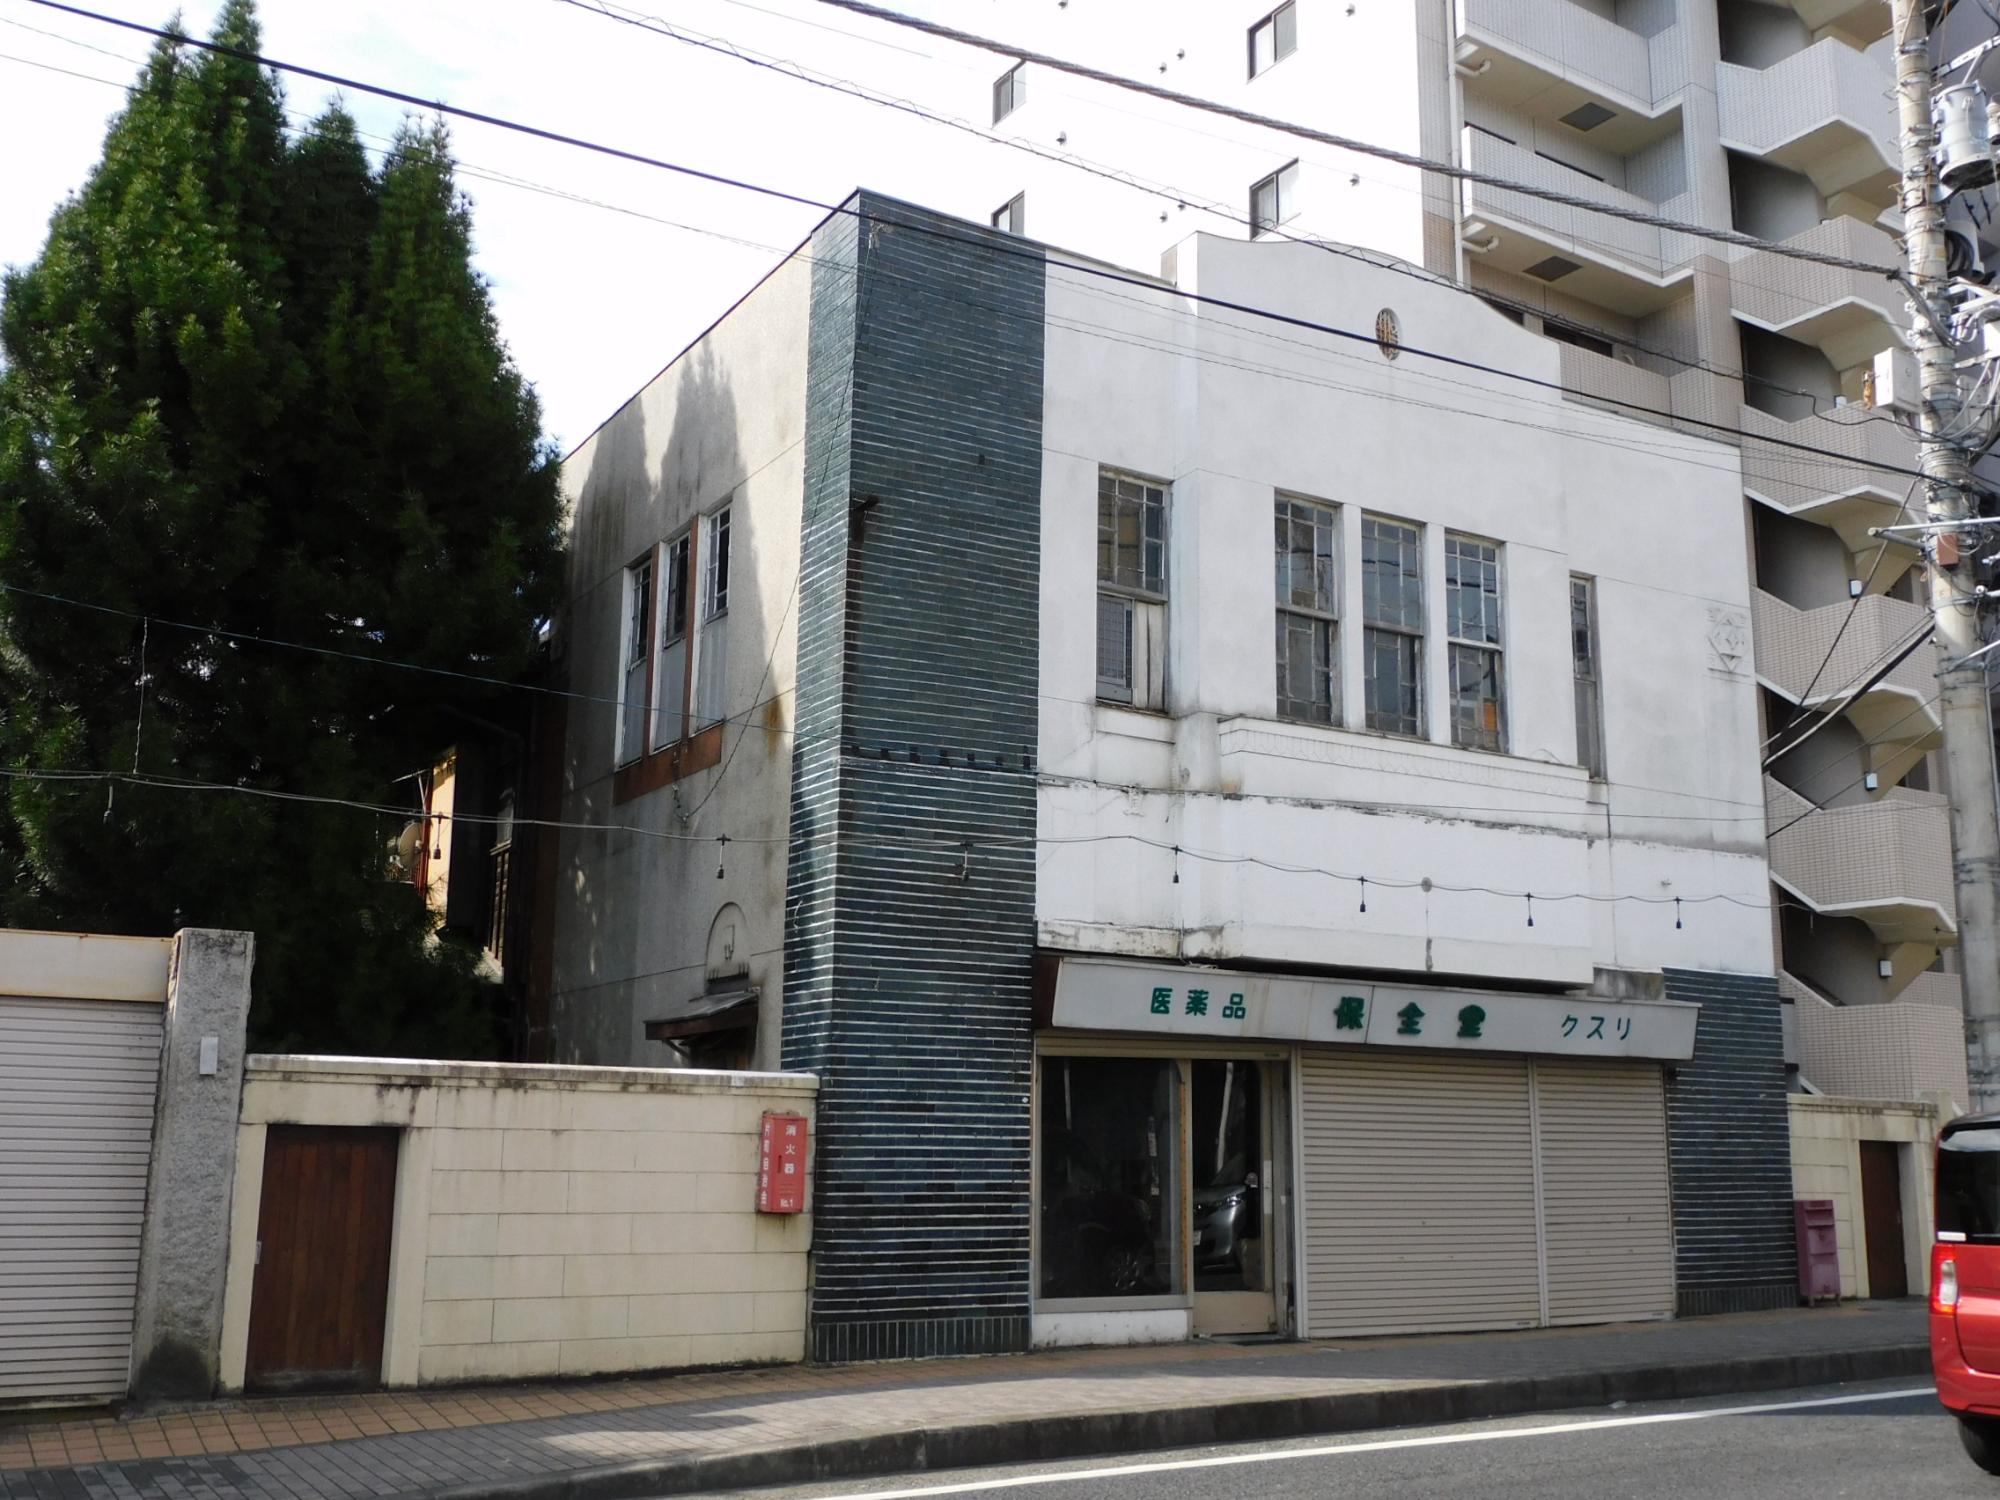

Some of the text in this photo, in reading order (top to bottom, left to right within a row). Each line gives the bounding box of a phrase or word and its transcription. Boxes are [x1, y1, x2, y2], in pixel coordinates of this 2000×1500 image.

[1150, 986, 1631, 1040] 医薬品 保全堂 クスリ
[784, 1124, 797, 1174] 消火器
